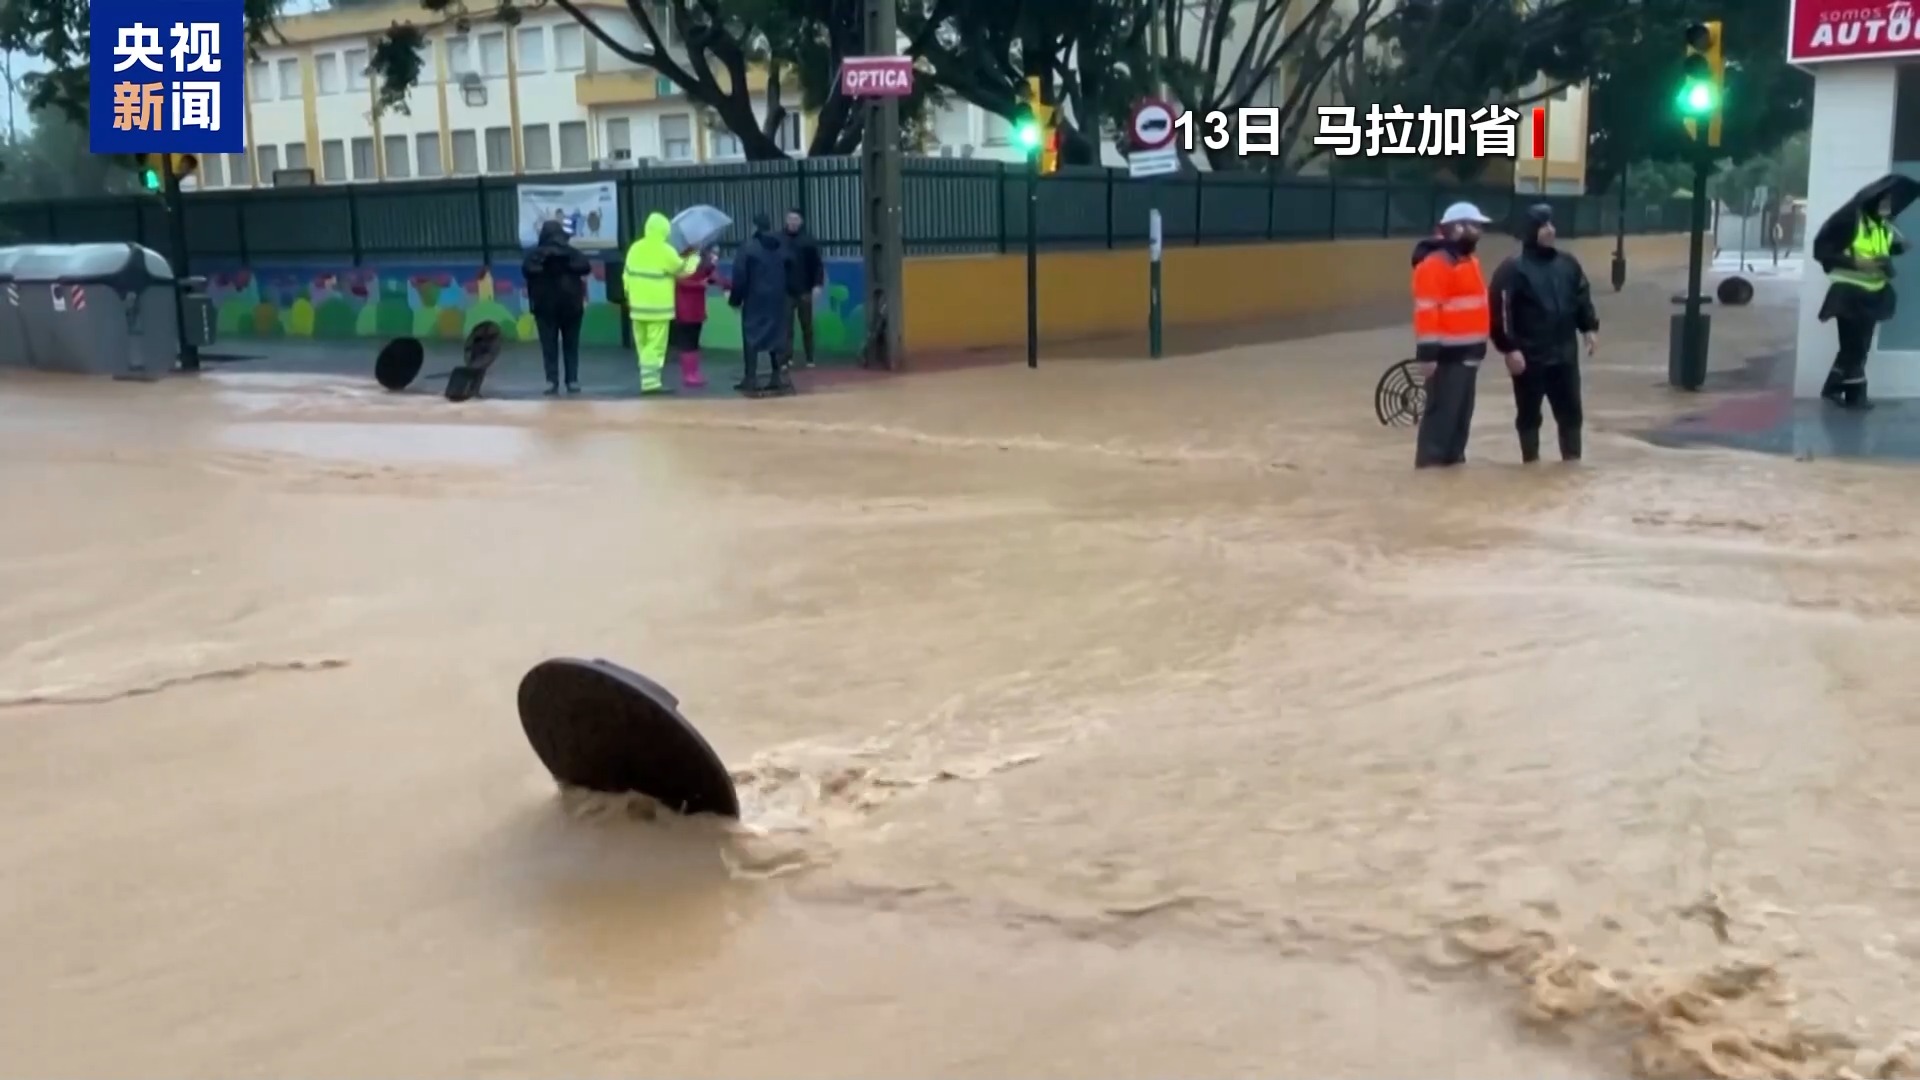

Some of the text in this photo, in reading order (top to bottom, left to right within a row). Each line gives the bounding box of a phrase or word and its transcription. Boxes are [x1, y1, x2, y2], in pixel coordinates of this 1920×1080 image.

[1820, 7, 1881, 22] somos
[1809, 18, 1920, 48] AUTO
[846, 69, 908, 87] OPTICA
